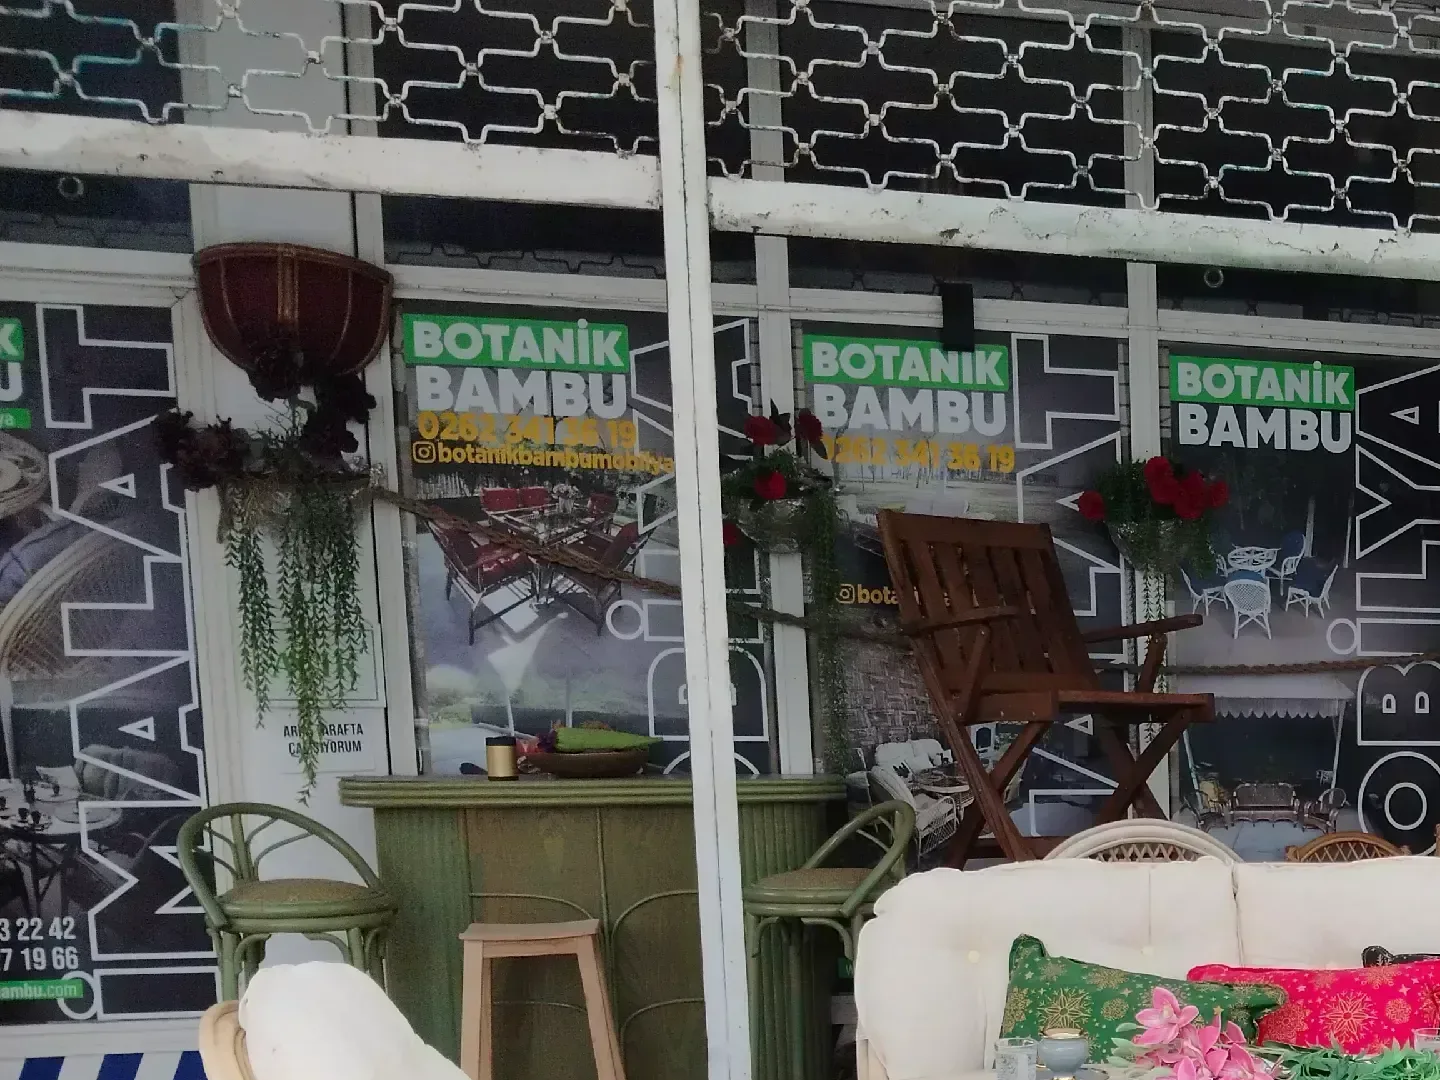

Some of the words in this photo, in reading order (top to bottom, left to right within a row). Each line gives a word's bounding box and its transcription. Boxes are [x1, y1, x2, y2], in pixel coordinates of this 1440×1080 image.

[415, 365, 627, 419] BAMBU
[814, 384, 1006, 436] BAMBU
[417, 411, 497, 444] 0262
[504, 416, 555, 445] 341
[564, 417, 599, 447] 36
[608, 420, 637, 449] 19
[1178, 403, 1351, 453] BAMBU
[986, 445, 1015, 473] 19
[16, 917, 44, 941] 22
[48, 916, 77, 940] 42
[20, 947, 47, 971] 19
[52, 946, 79, 970] 66
